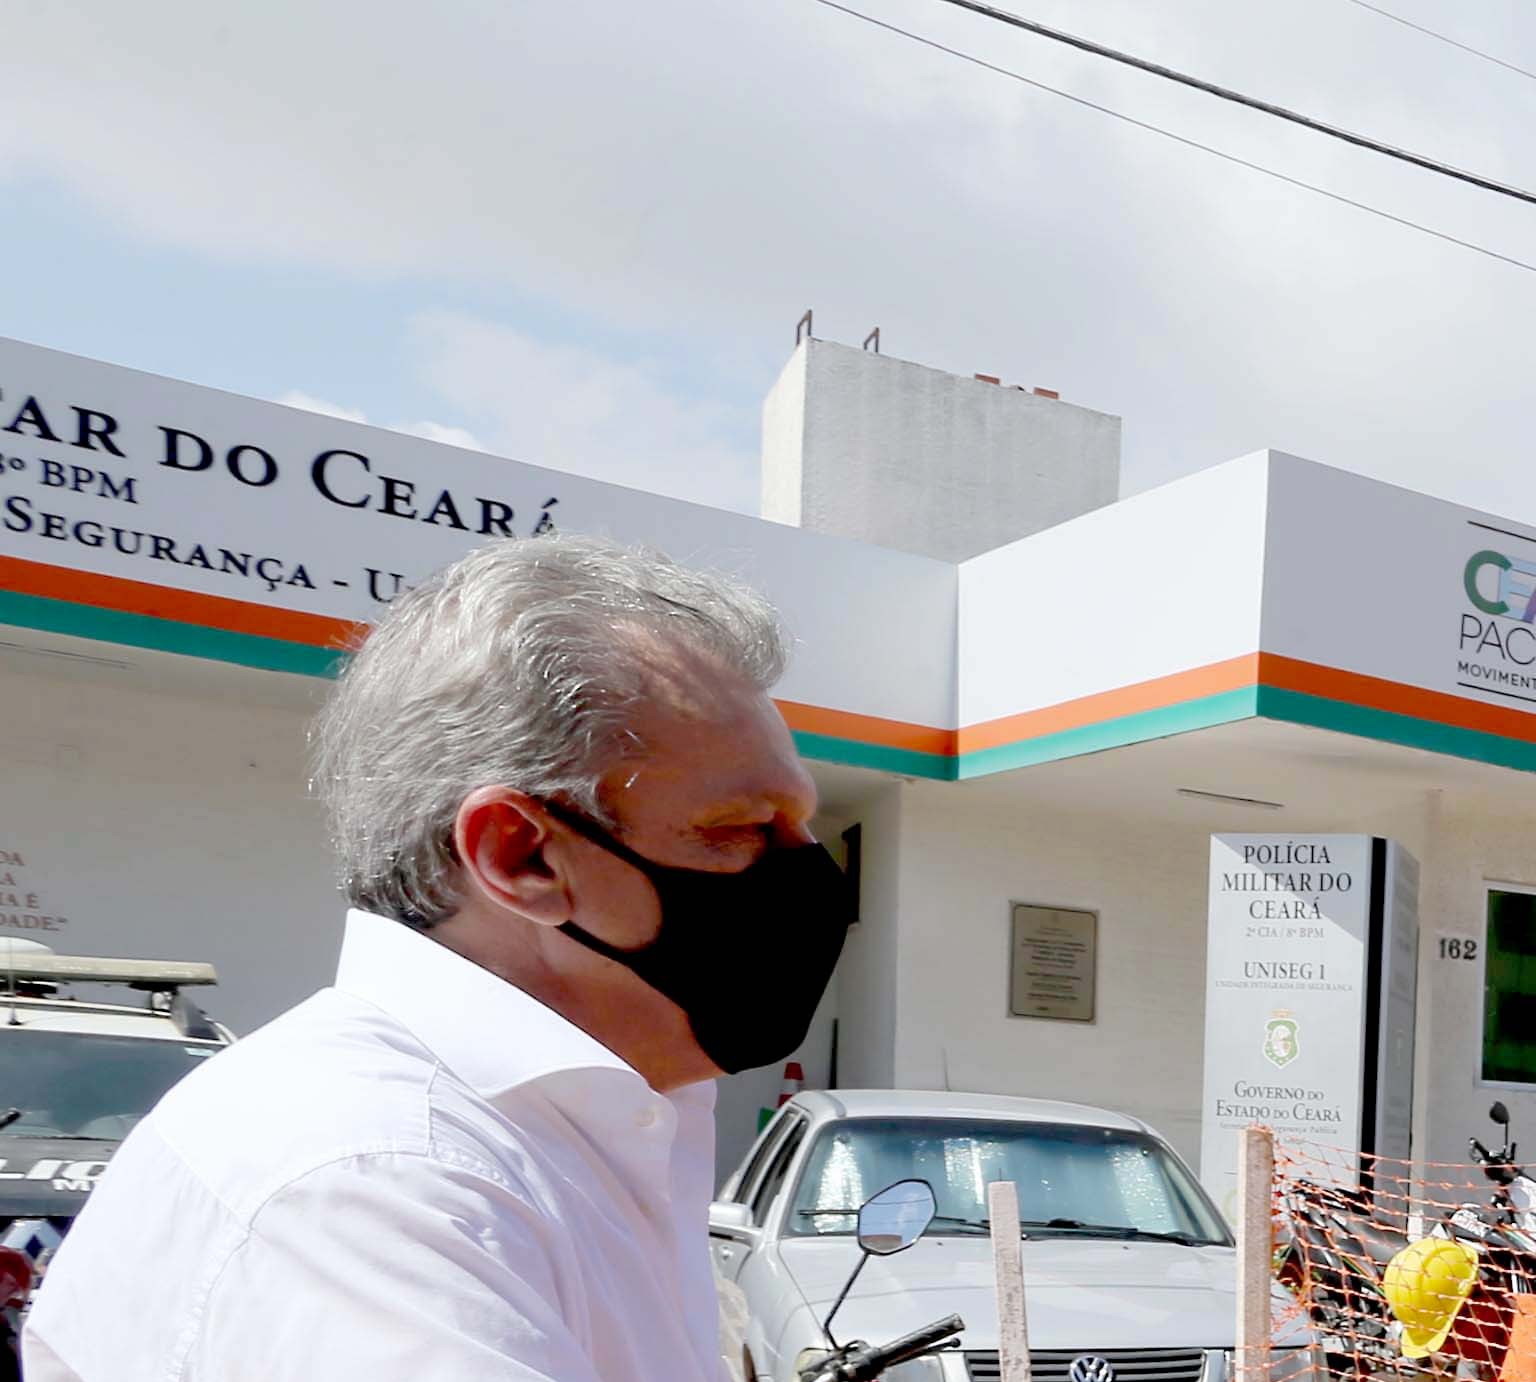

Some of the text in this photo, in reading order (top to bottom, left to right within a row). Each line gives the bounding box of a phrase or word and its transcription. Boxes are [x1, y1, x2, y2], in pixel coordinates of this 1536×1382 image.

[0, 388, 127, 459] AR
[156, 424, 279, 488] DO
[39, 458, 139, 505] BPM
[1243, 840, 1332, 865] POLÍCIA
[1221, 872, 1353, 893] MILITAR DO
[1248, 896, 1323, 920] CEARÁ
[1439, 937, 1477, 960] 162
[1243, 960, 1313, 981] UNISEG
